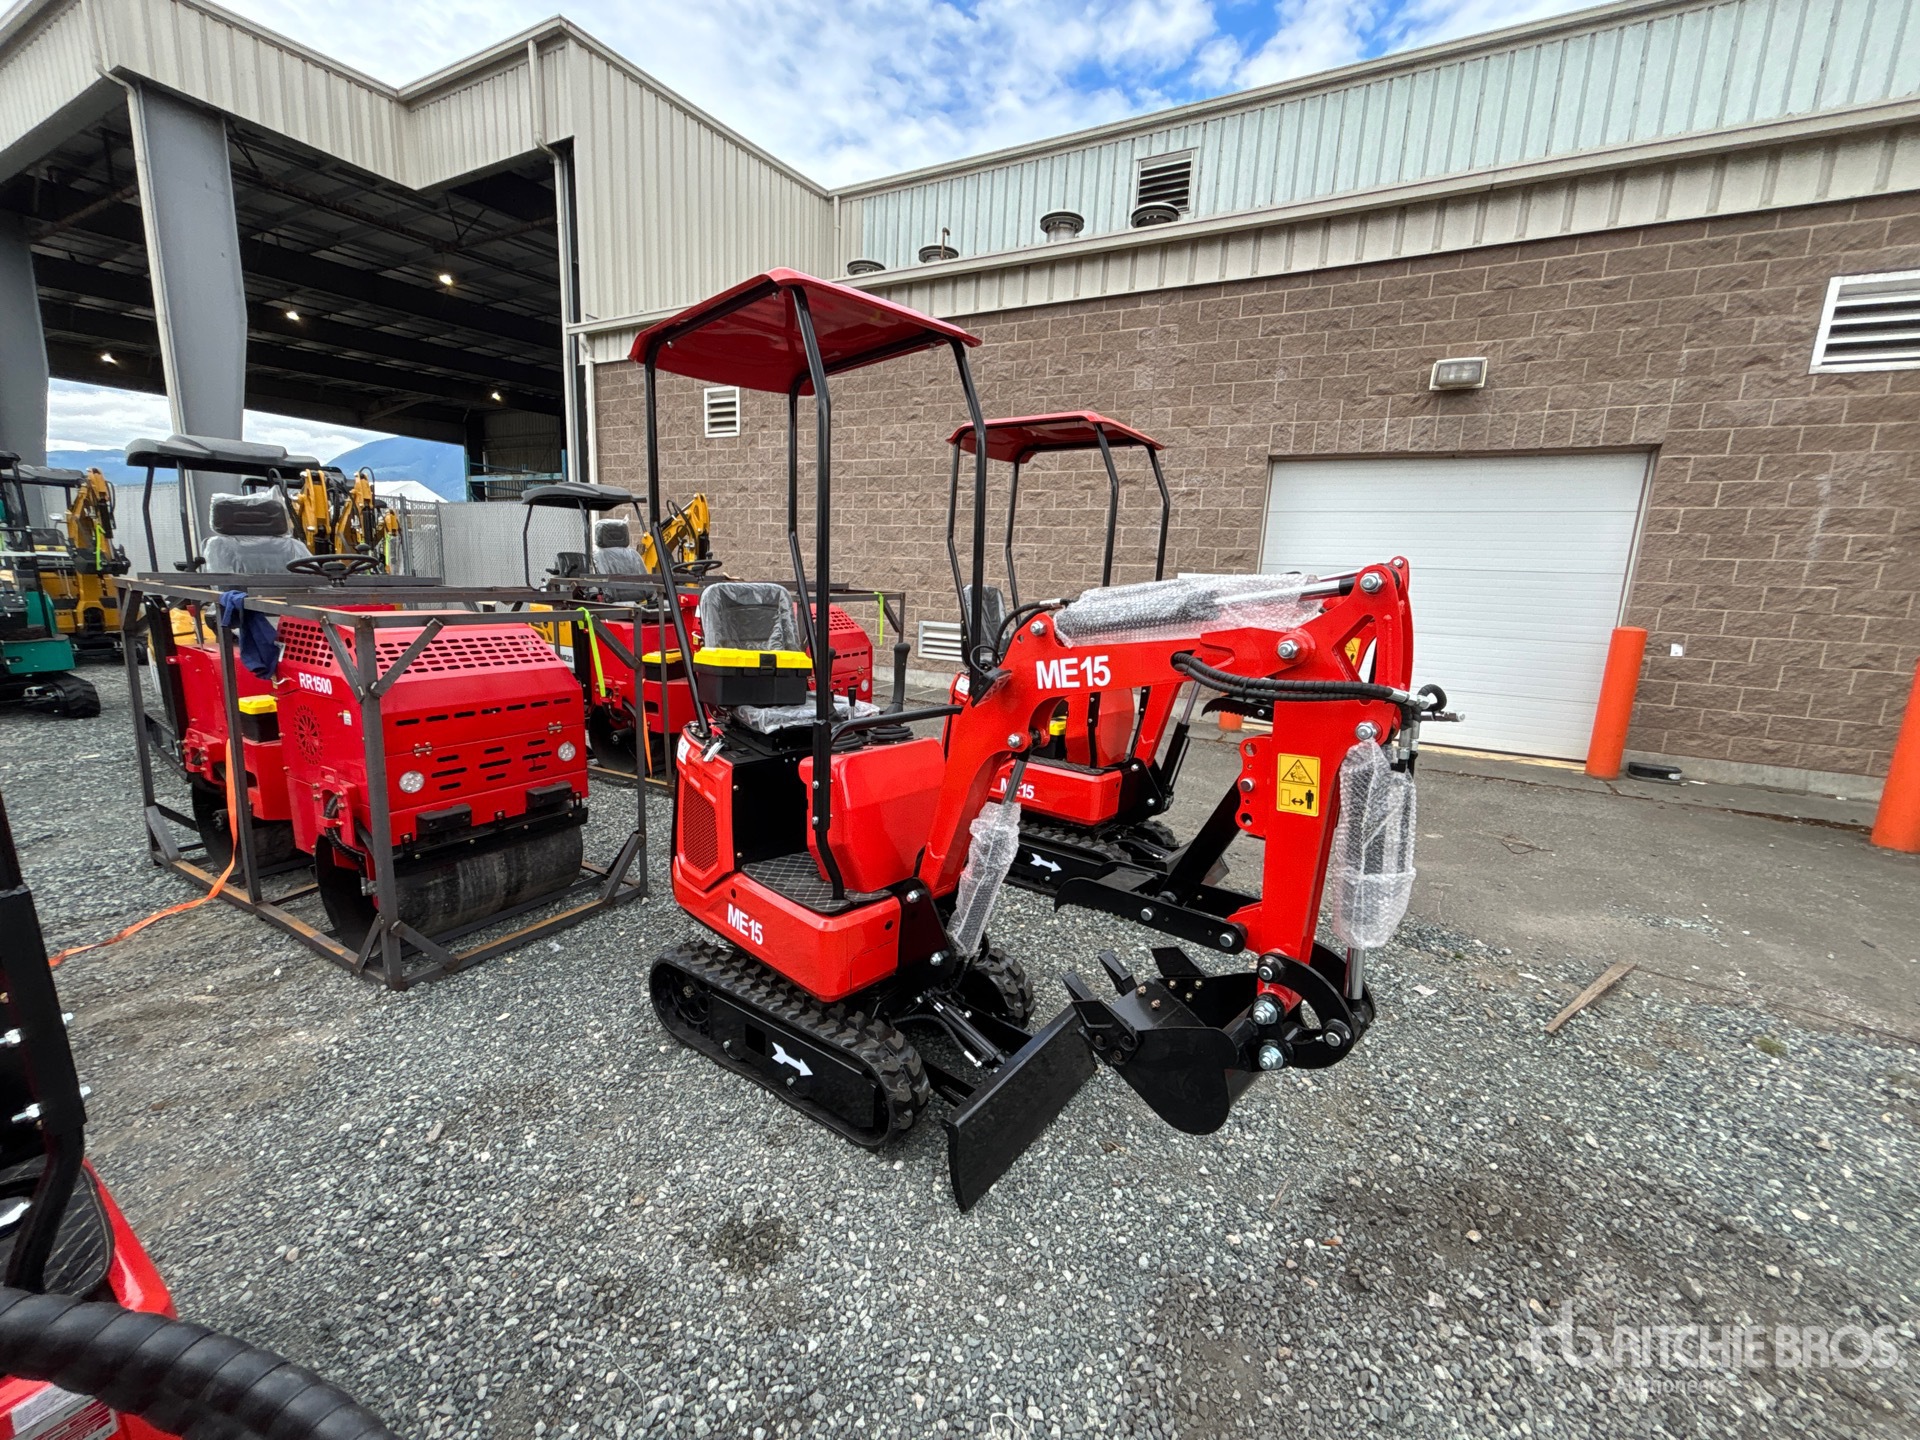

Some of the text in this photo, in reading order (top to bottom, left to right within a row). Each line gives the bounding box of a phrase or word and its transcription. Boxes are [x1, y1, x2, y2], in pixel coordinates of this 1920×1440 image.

[299, 672, 333, 695] RR1500
[1036, 655, 1111, 690] ME15
[727, 903, 764, 945] ME15
